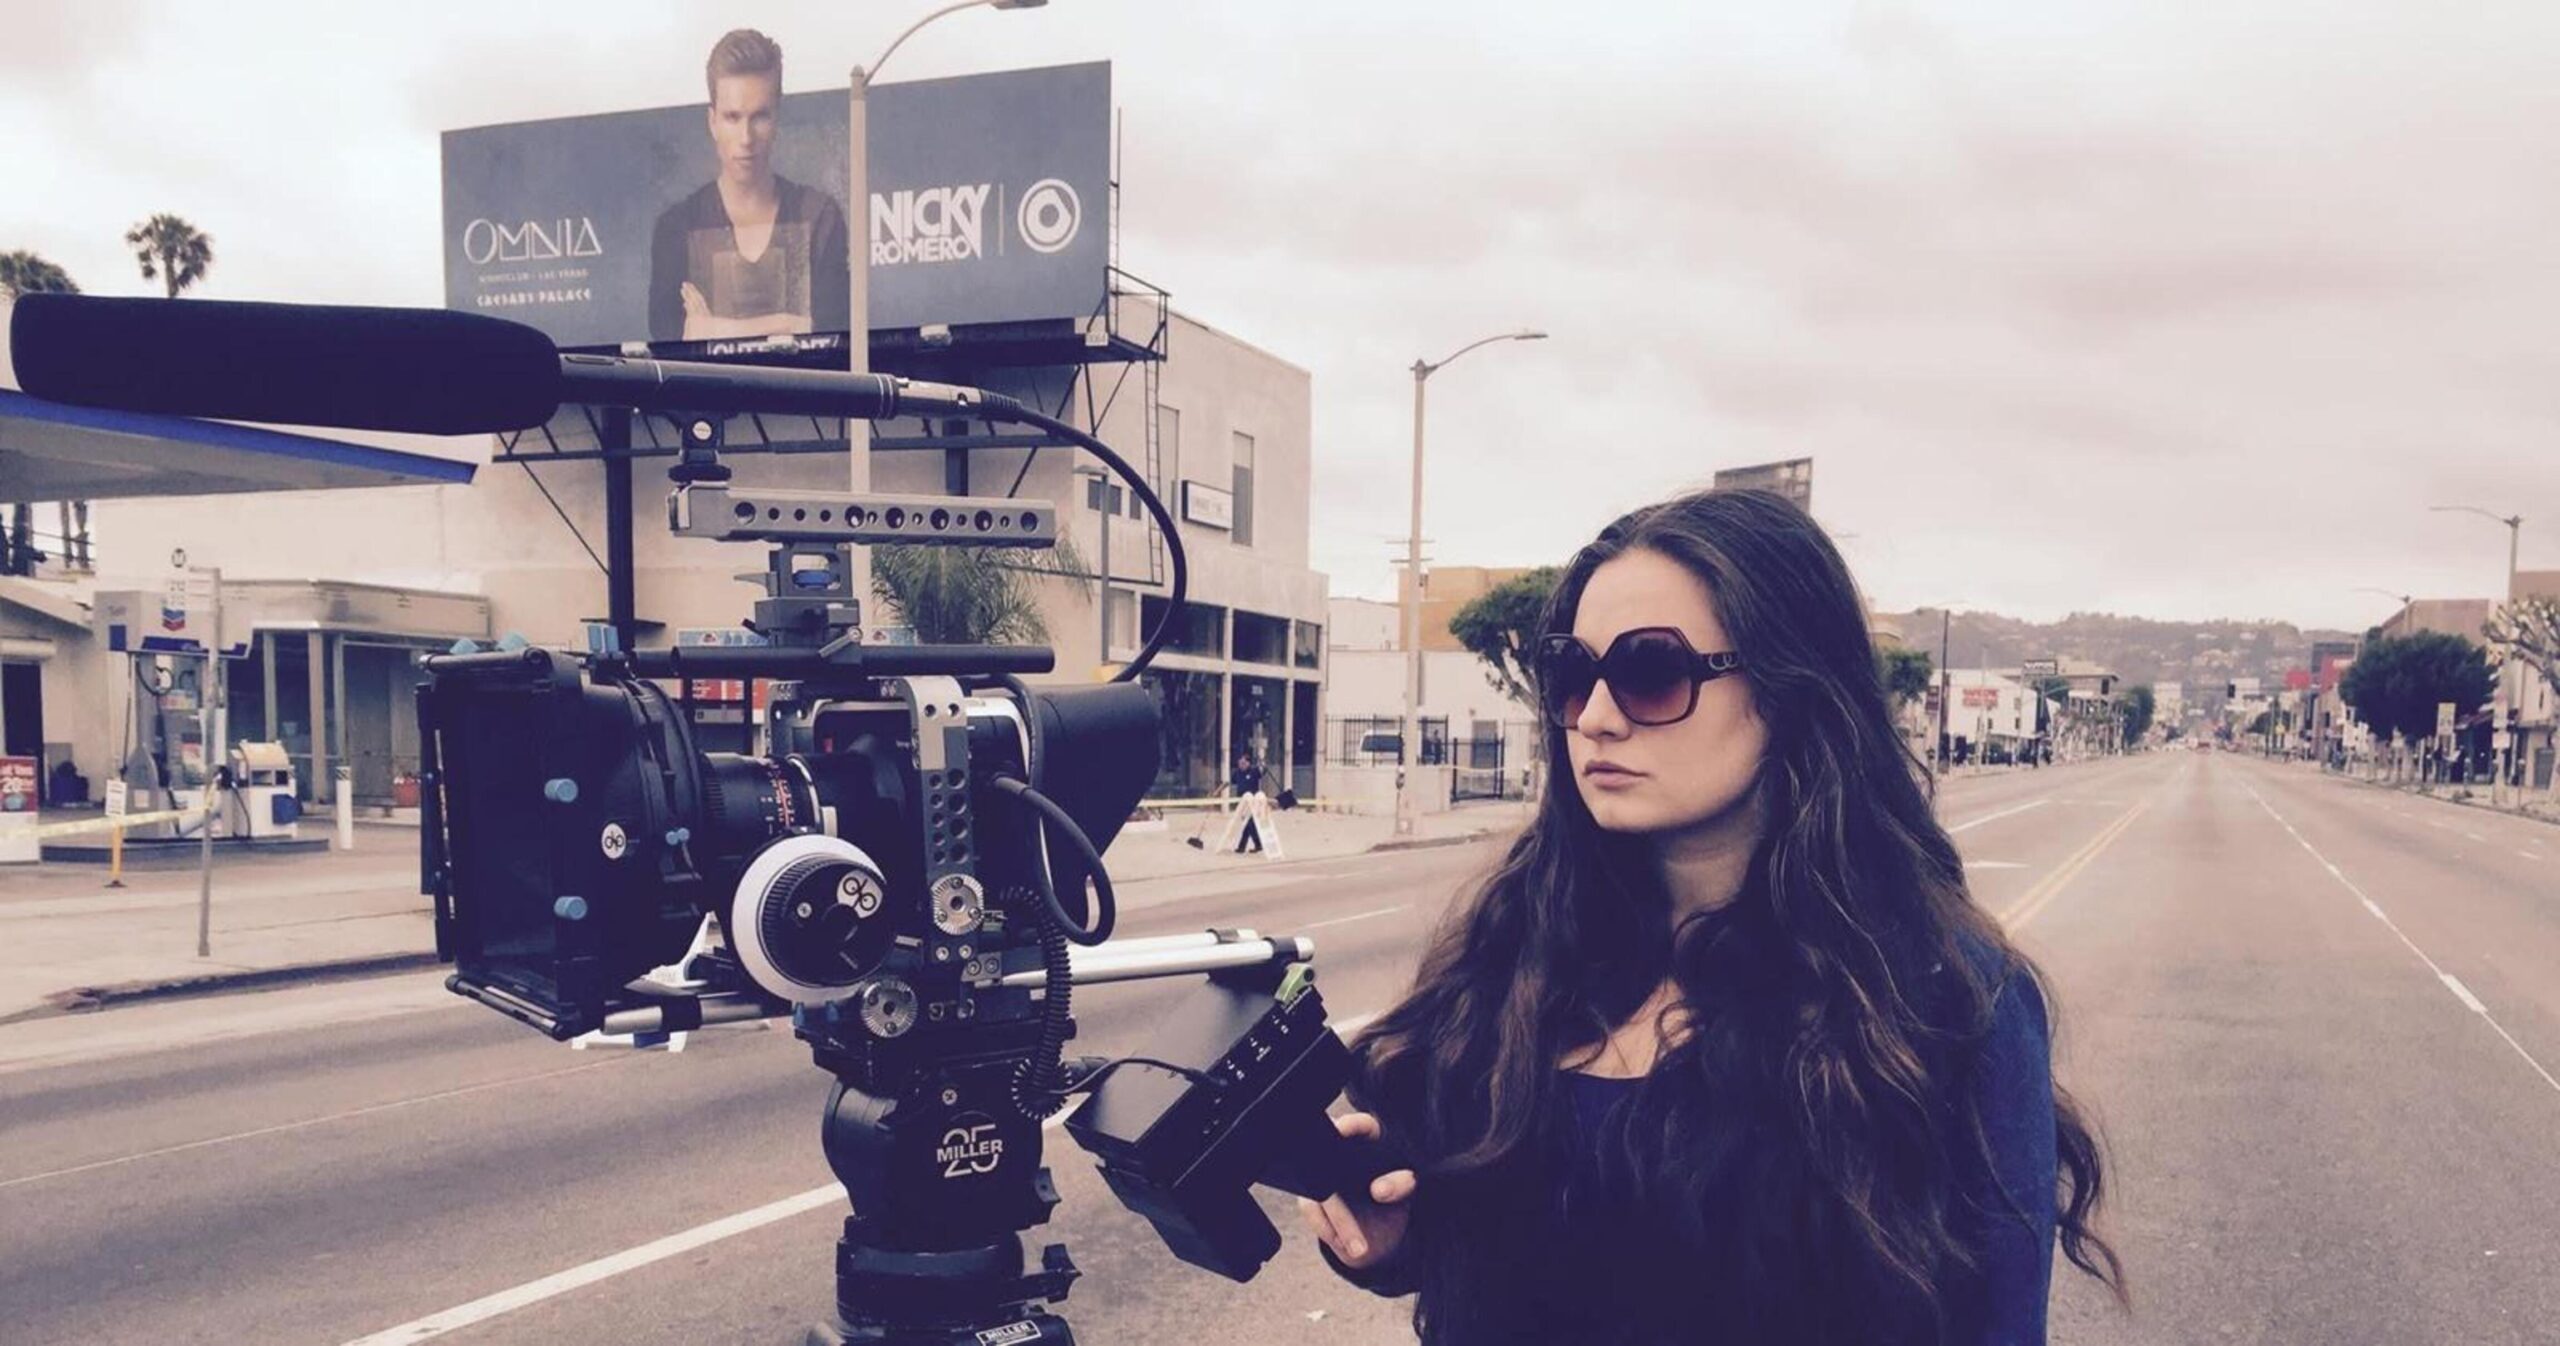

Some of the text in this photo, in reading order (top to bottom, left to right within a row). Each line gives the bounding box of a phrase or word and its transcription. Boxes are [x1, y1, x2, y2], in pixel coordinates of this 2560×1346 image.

[869, 183, 991, 260] NICKY
[463, 216, 603, 265] OMNIA
[869, 233, 972, 267] ROMERO
[538, 287, 593, 304] PALACE
[935, 1139, 1004, 1163] MILLER
[984, 1324, 1031, 1343] MILLER
